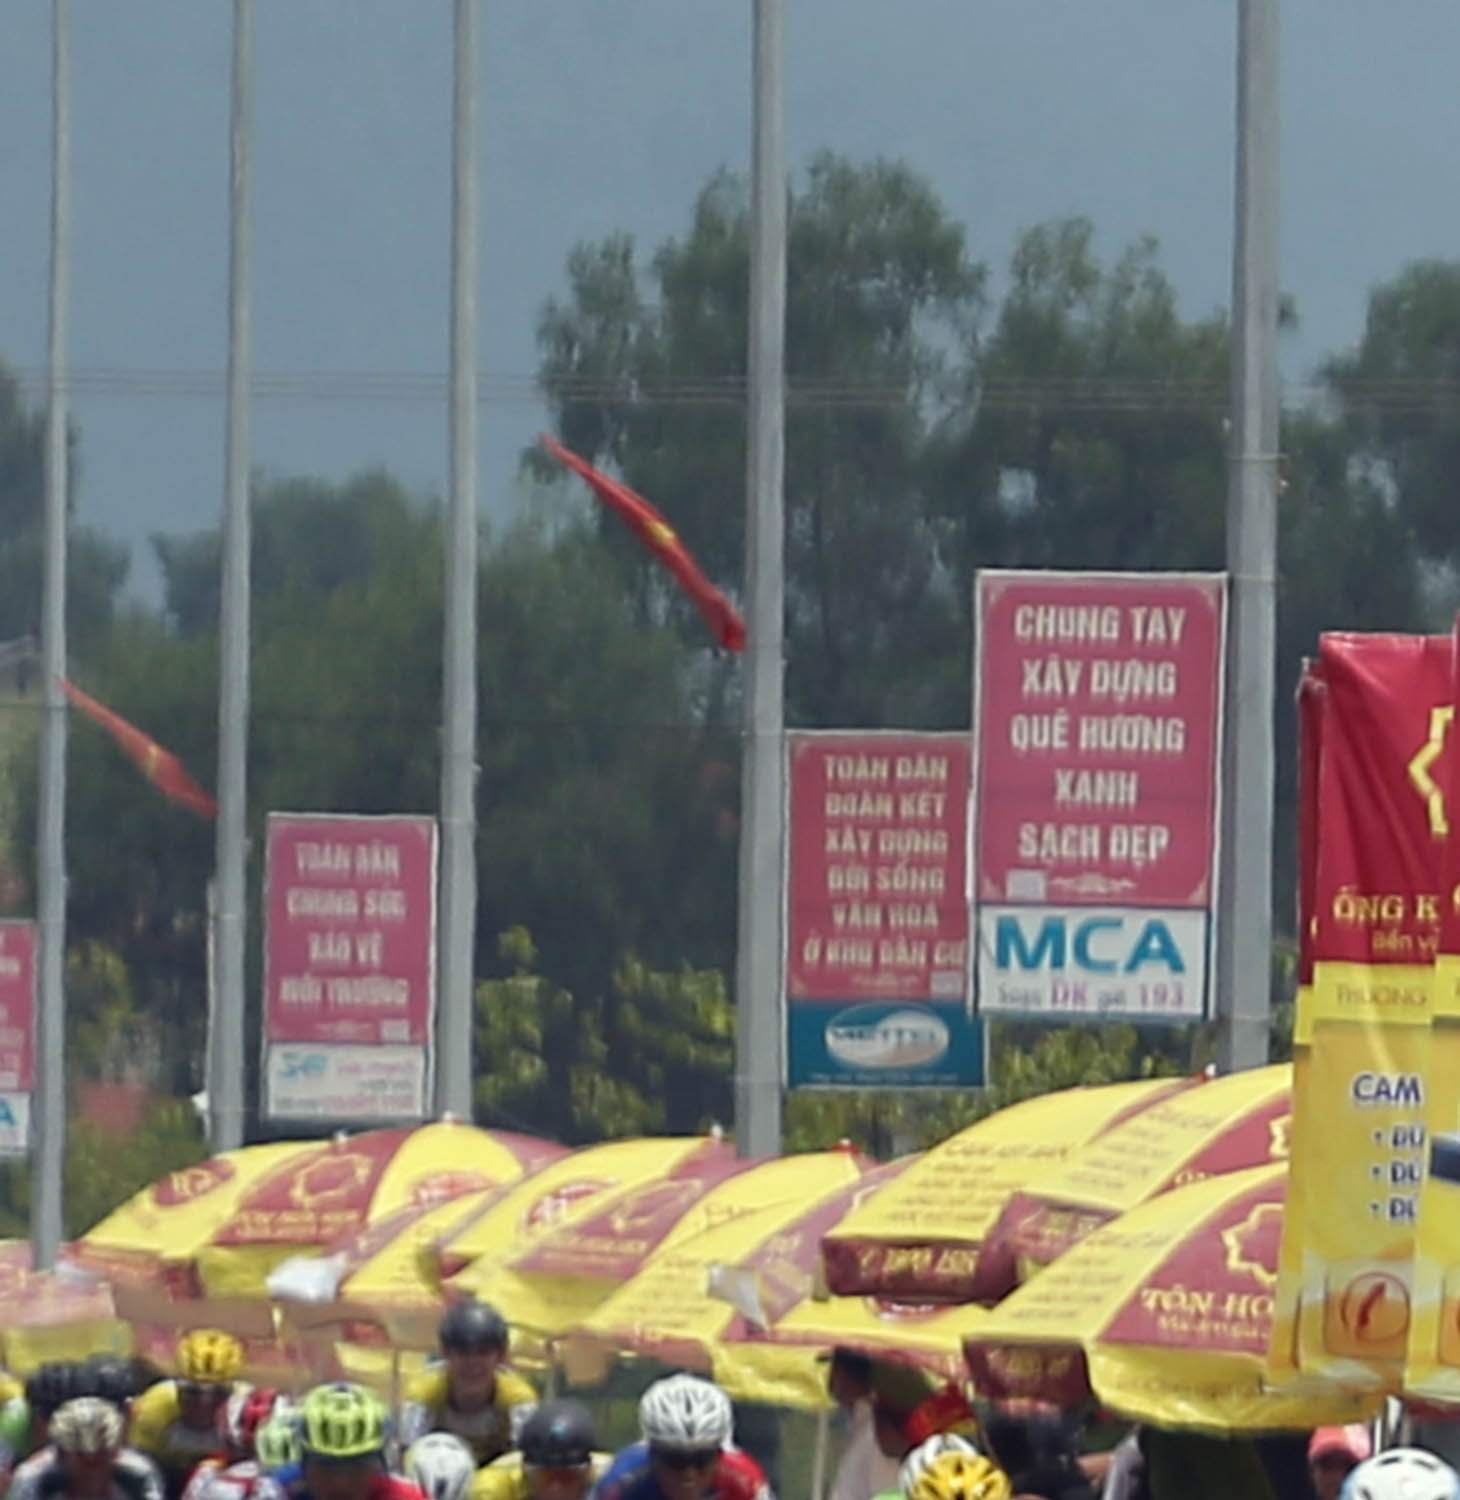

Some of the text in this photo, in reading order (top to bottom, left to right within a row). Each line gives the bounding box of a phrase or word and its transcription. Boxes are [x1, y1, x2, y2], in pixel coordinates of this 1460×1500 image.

[1014, 606, 1186, 643] CHUNG TAY
[1022, 659, 1177, 704] XÂY DỰNG
[1011, 715, 1185, 753] QUÊ HƯƠNG
[1055, 770, 1138, 806] XANH
[1019, 824, 1169, 872] SẠCH ĐẸP
[995, 916, 1186, 976] MCA
[1353, 1074, 1422, 1103] CAM
